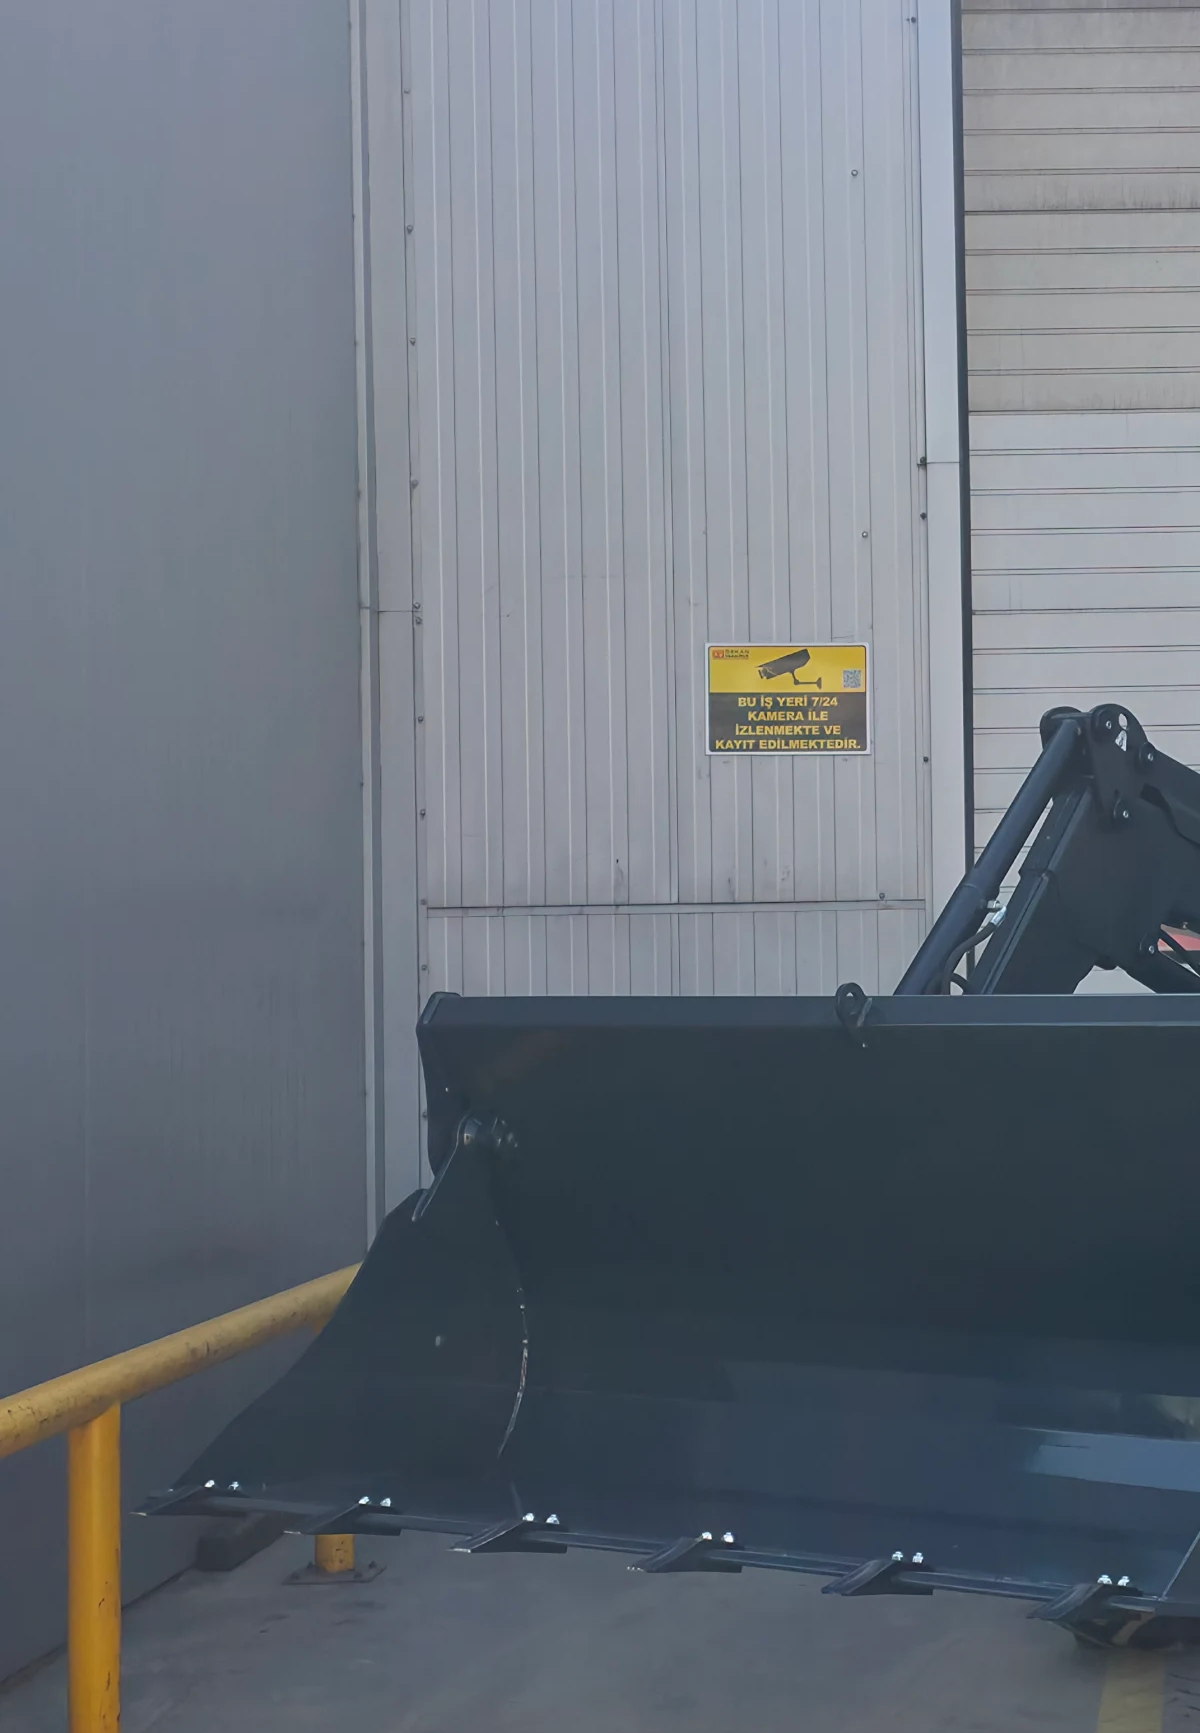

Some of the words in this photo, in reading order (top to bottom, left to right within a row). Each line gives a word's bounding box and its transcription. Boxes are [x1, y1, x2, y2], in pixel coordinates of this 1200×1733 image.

[737, 697, 757, 708] BU
[760, 695, 773, 710] İŞ
[776, 695, 808, 707] YERİ
[811, 697, 838, 707] 7/24
[747, 711, 804, 722] KAMERA
[735, 723, 820, 736] İZLENMEKTE
[823, 725, 841, 736] VE
[715, 739, 756, 750] KAYIT
[759, 737, 861, 750] EDİLMEKTEDİR.
